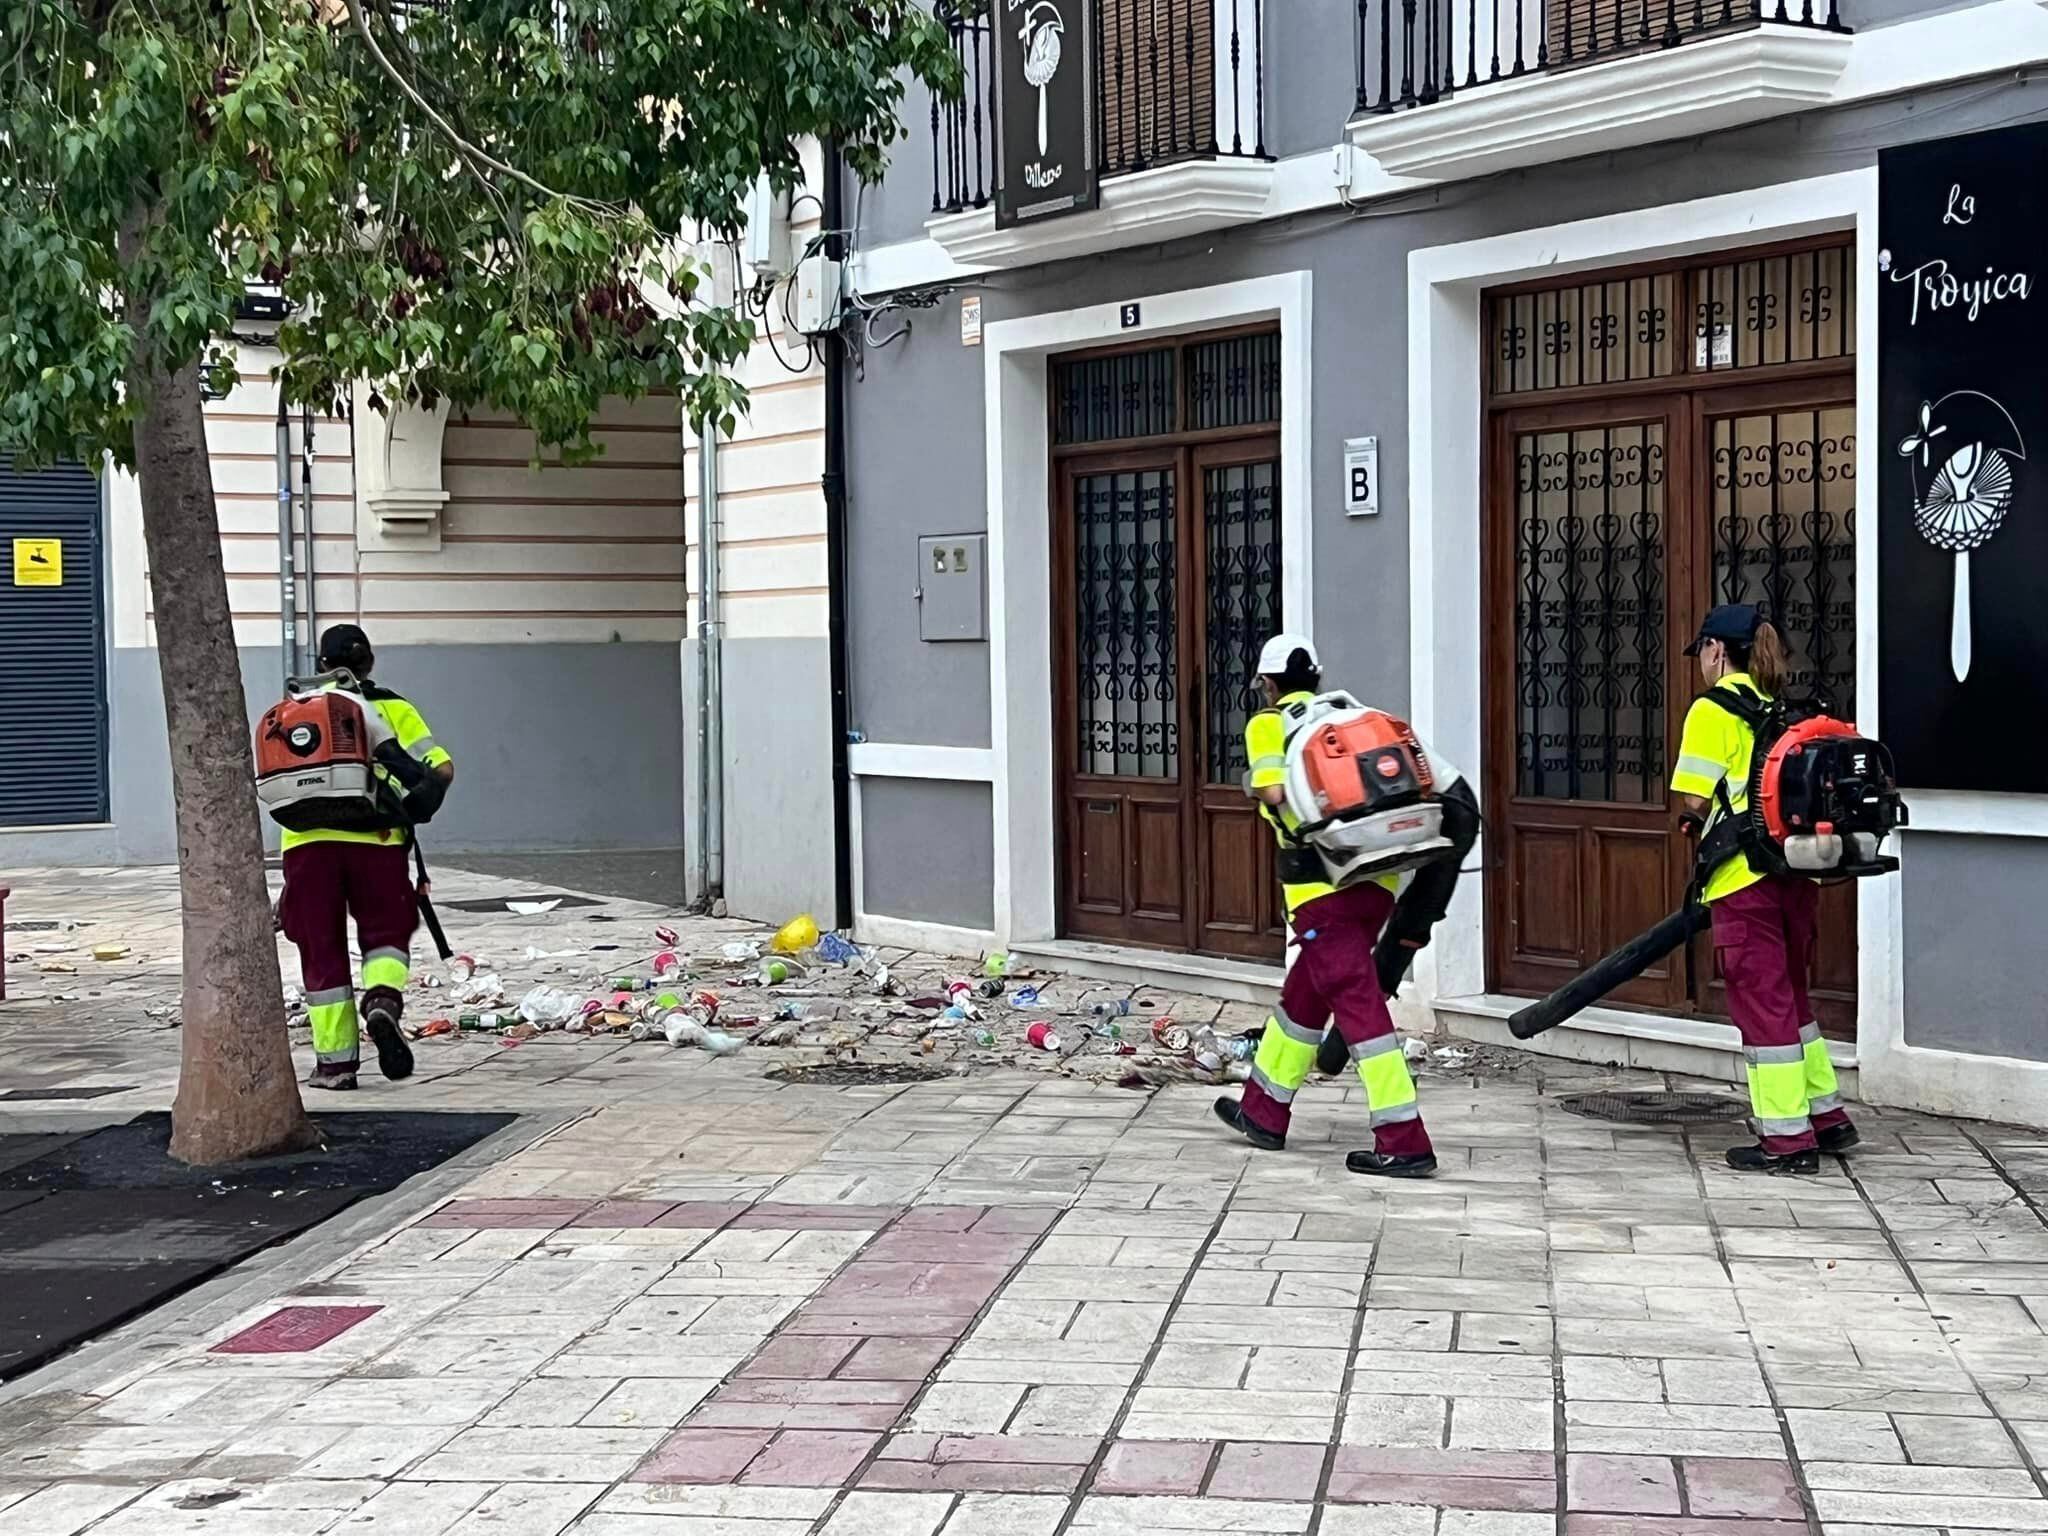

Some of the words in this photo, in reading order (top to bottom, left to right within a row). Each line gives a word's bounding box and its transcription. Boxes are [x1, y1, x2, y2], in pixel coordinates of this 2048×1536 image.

[1943, 184, 1975, 224] La
[1891, 259, 2034, 325] Troyica
[1127, 306, 1135, 325] 5
[1352, 467, 1369, 502] B
